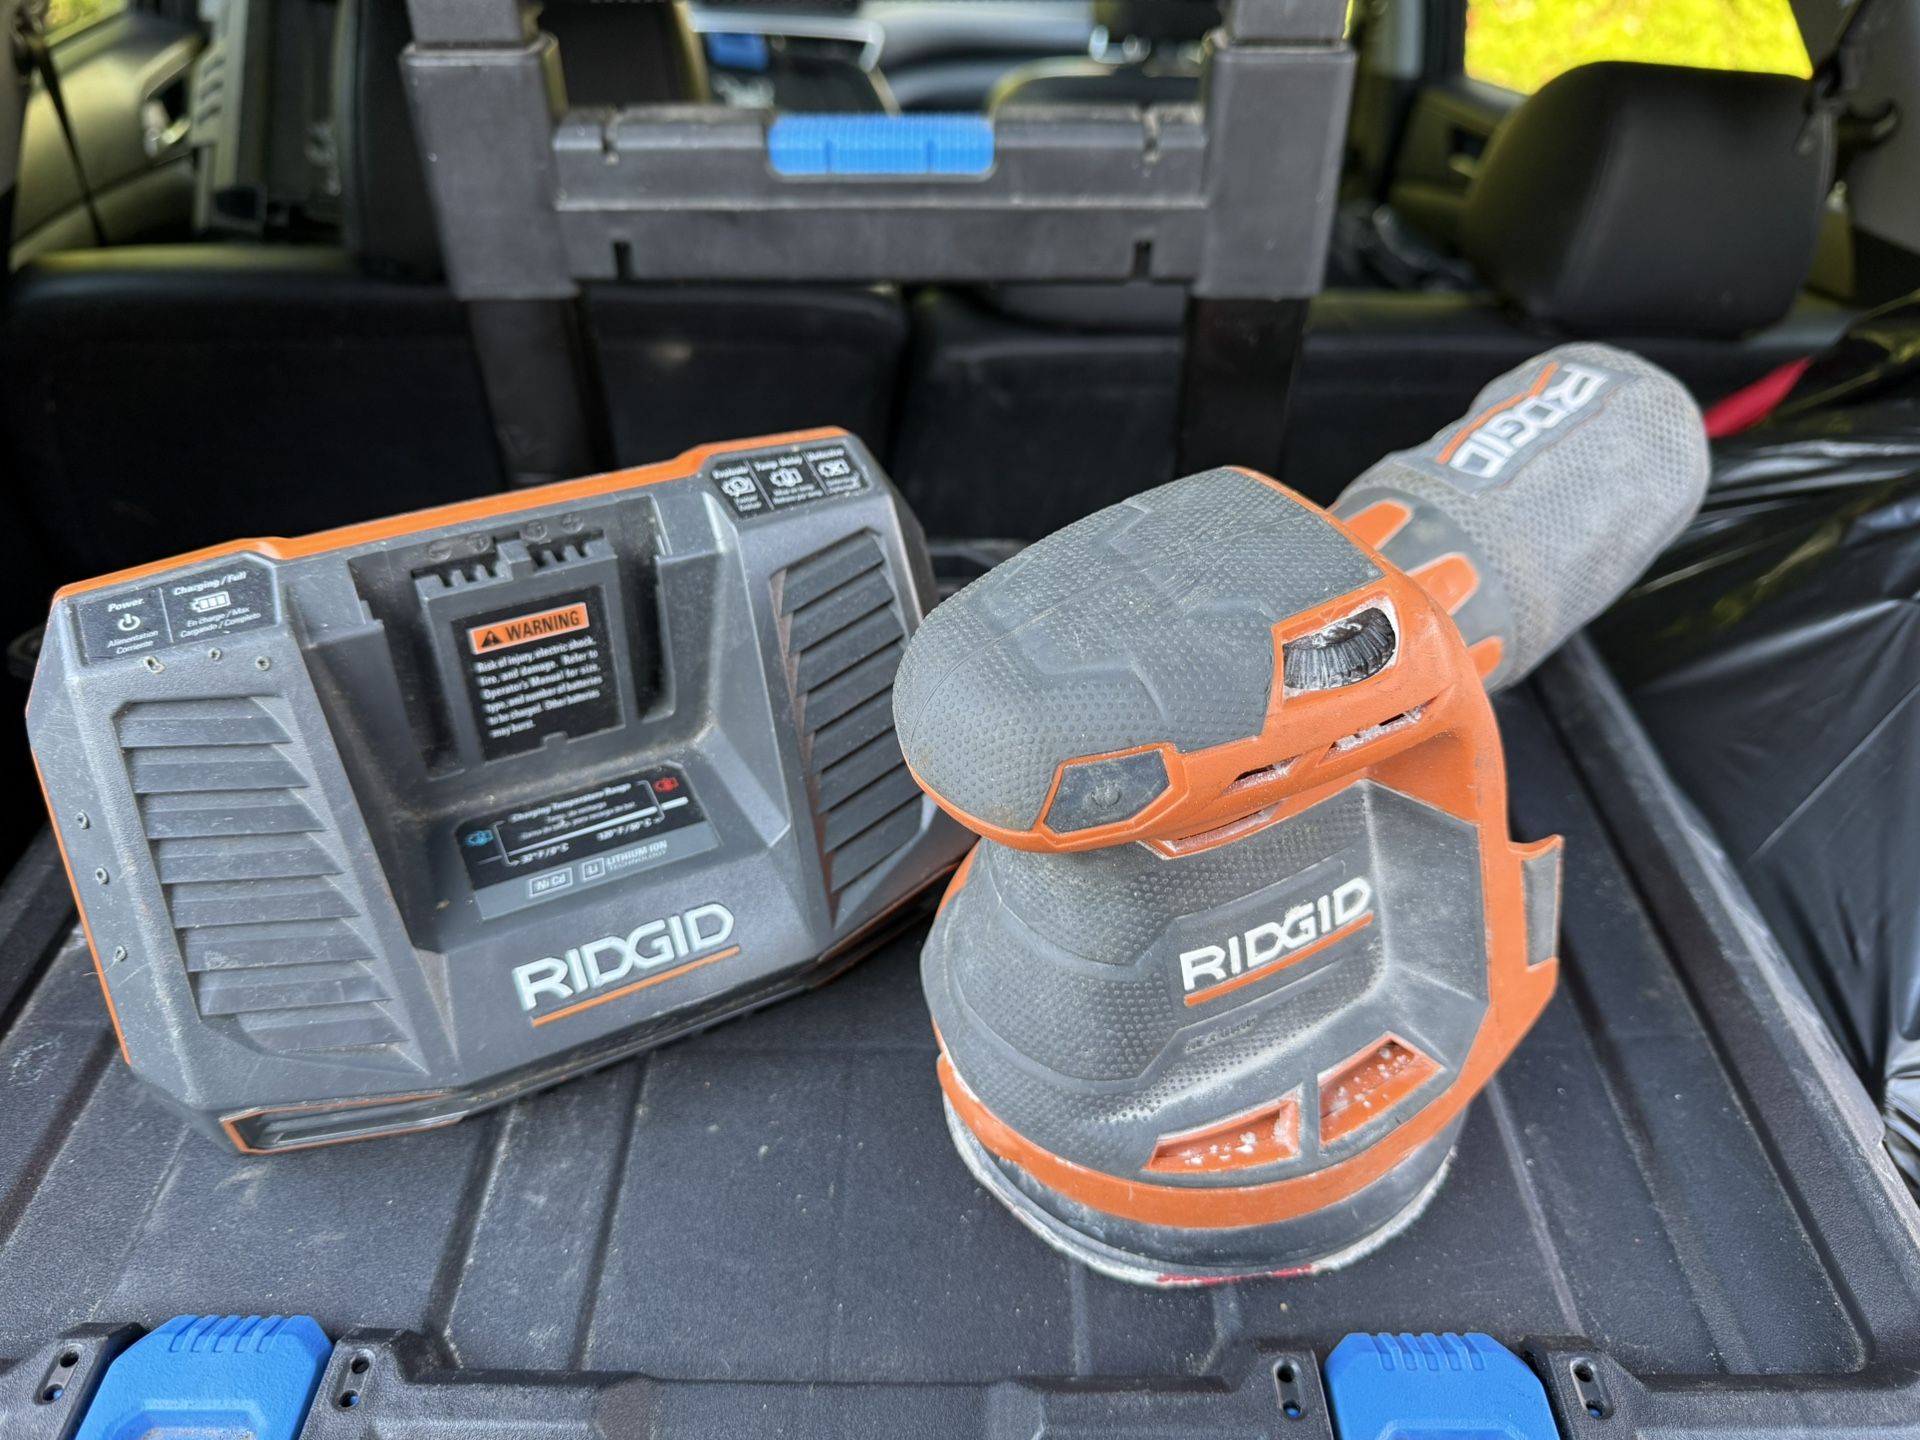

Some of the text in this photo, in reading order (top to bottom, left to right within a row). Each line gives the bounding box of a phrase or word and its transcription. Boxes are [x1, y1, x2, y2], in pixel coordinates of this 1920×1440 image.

[1448, 363, 1608, 478] RDGID
[173, 580, 220, 596] Charging
[505, 610, 580, 641] WARNING
[475, 661, 498, 673] Risk
[535, 644, 568, 659] electric
[500, 668, 519, 681] and
[561, 652, 587, 665] Refer
[587, 650, 598, 660] to
[525, 687, 556, 701] number
[566, 676, 603, 691] batteries
[529, 671, 564, 686] Manual
[564, 668, 578, 678] for
[567, 689, 600, 705] batteries
[606, 840, 668, 865] LITHIUM ION
[1180, 876, 1372, 990] RIDGID
[512, 903, 735, 1011] RIDGID
